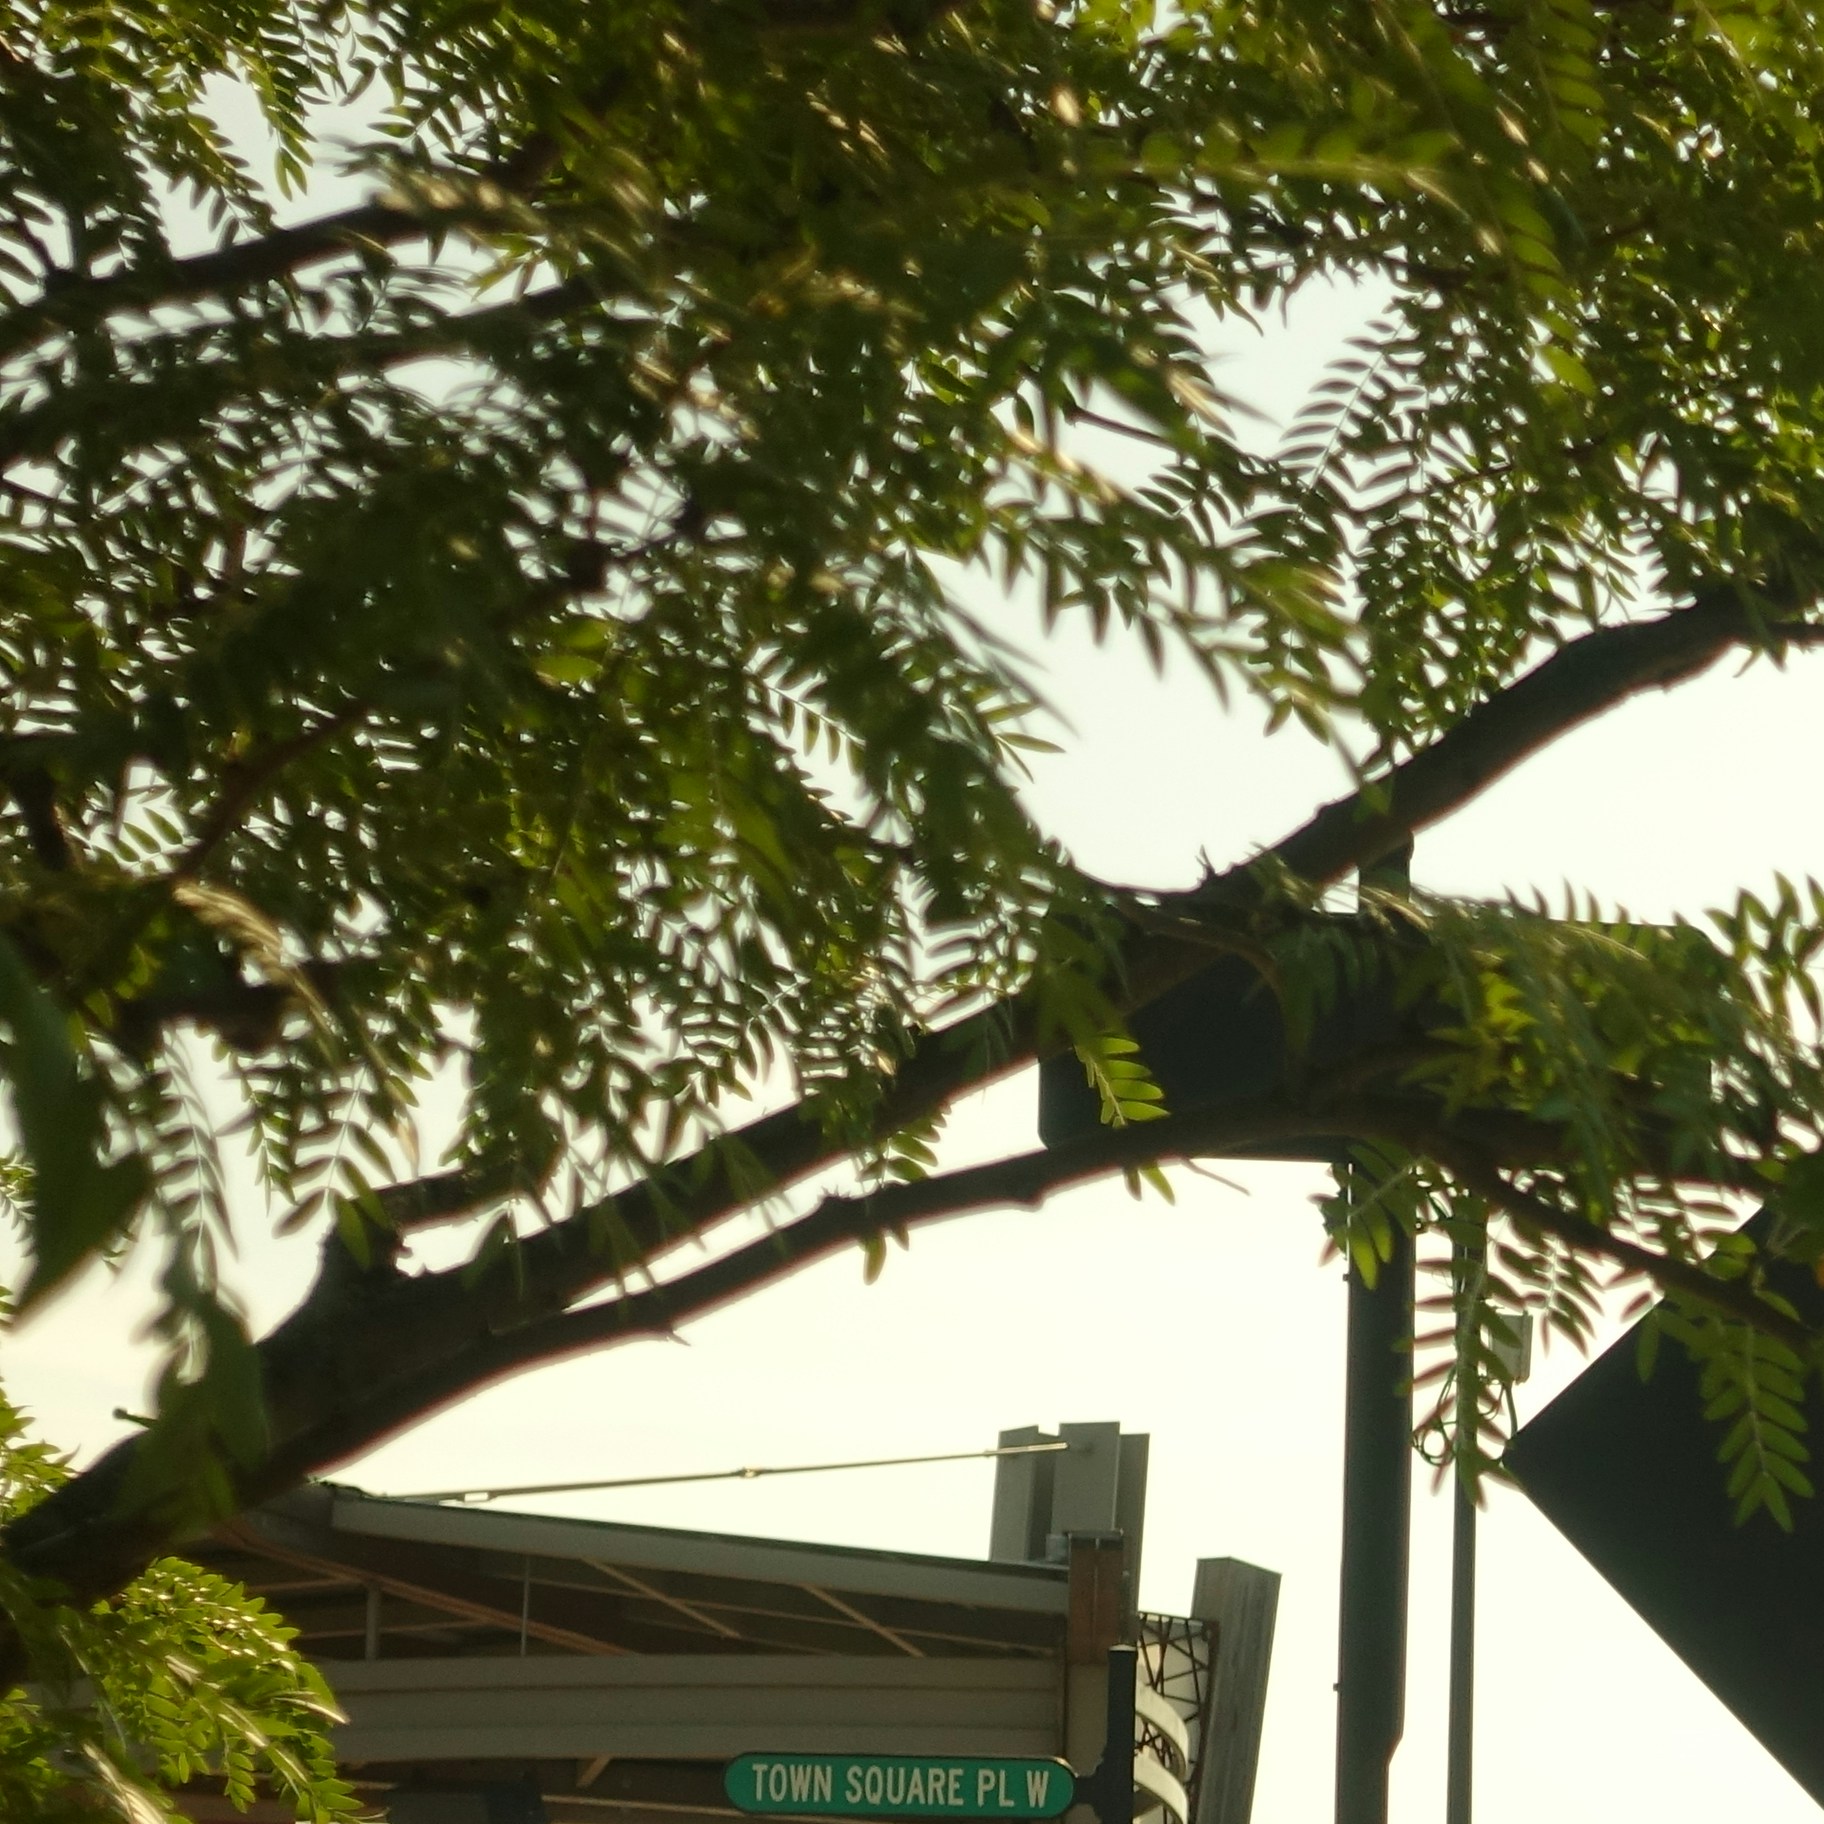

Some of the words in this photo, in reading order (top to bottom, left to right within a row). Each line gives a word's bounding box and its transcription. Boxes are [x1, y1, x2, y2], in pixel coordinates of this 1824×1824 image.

[752, 1763, 832, 1802] TOWN
[845, 1765, 964, 1806] SQUARE
[977, 1769, 1014, 1807] PL
[1026, 1770, 1049, 1808] W
